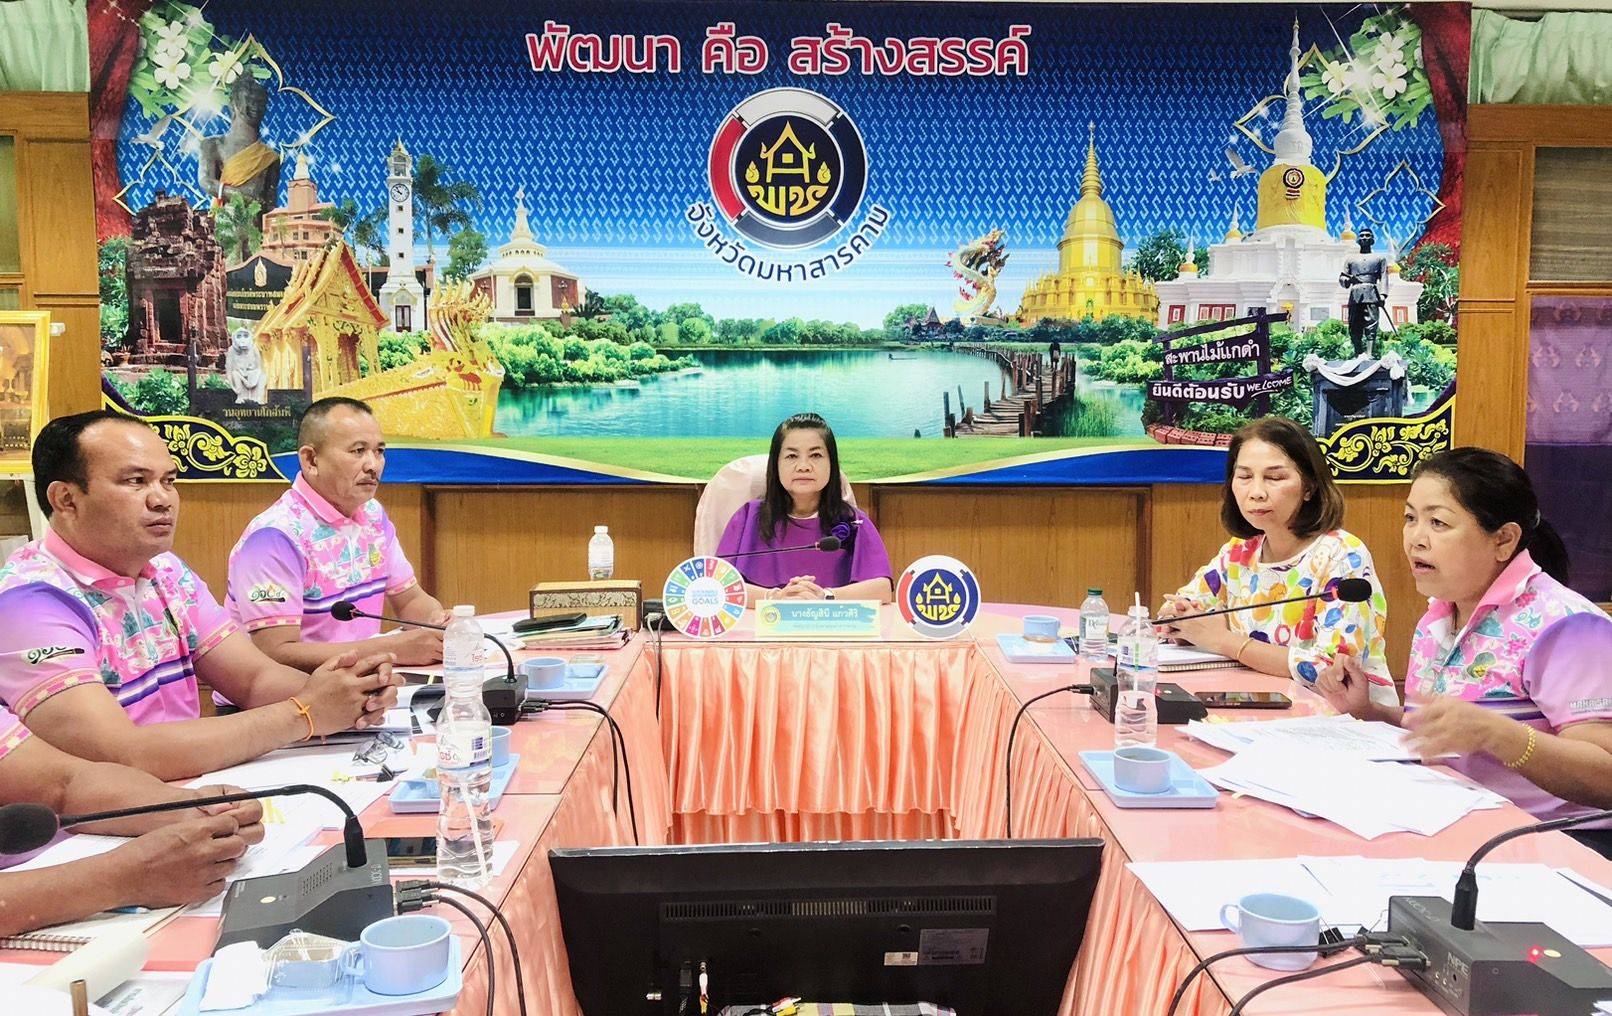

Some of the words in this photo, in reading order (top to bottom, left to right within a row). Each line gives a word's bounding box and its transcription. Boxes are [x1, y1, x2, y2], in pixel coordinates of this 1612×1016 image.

[526, 20, 680, 73] พัฒนา
[701, 22, 768, 74] คือ
[788, 23, 1032, 76] สร้างสรรค์
[686, 202, 890, 282] จังหวัดมหาสารคาม
[1165, 339, 1260, 365] สะพานไม้แกดำ
[1152, 382, 1245, 400] ยินดีต้อนรับ
